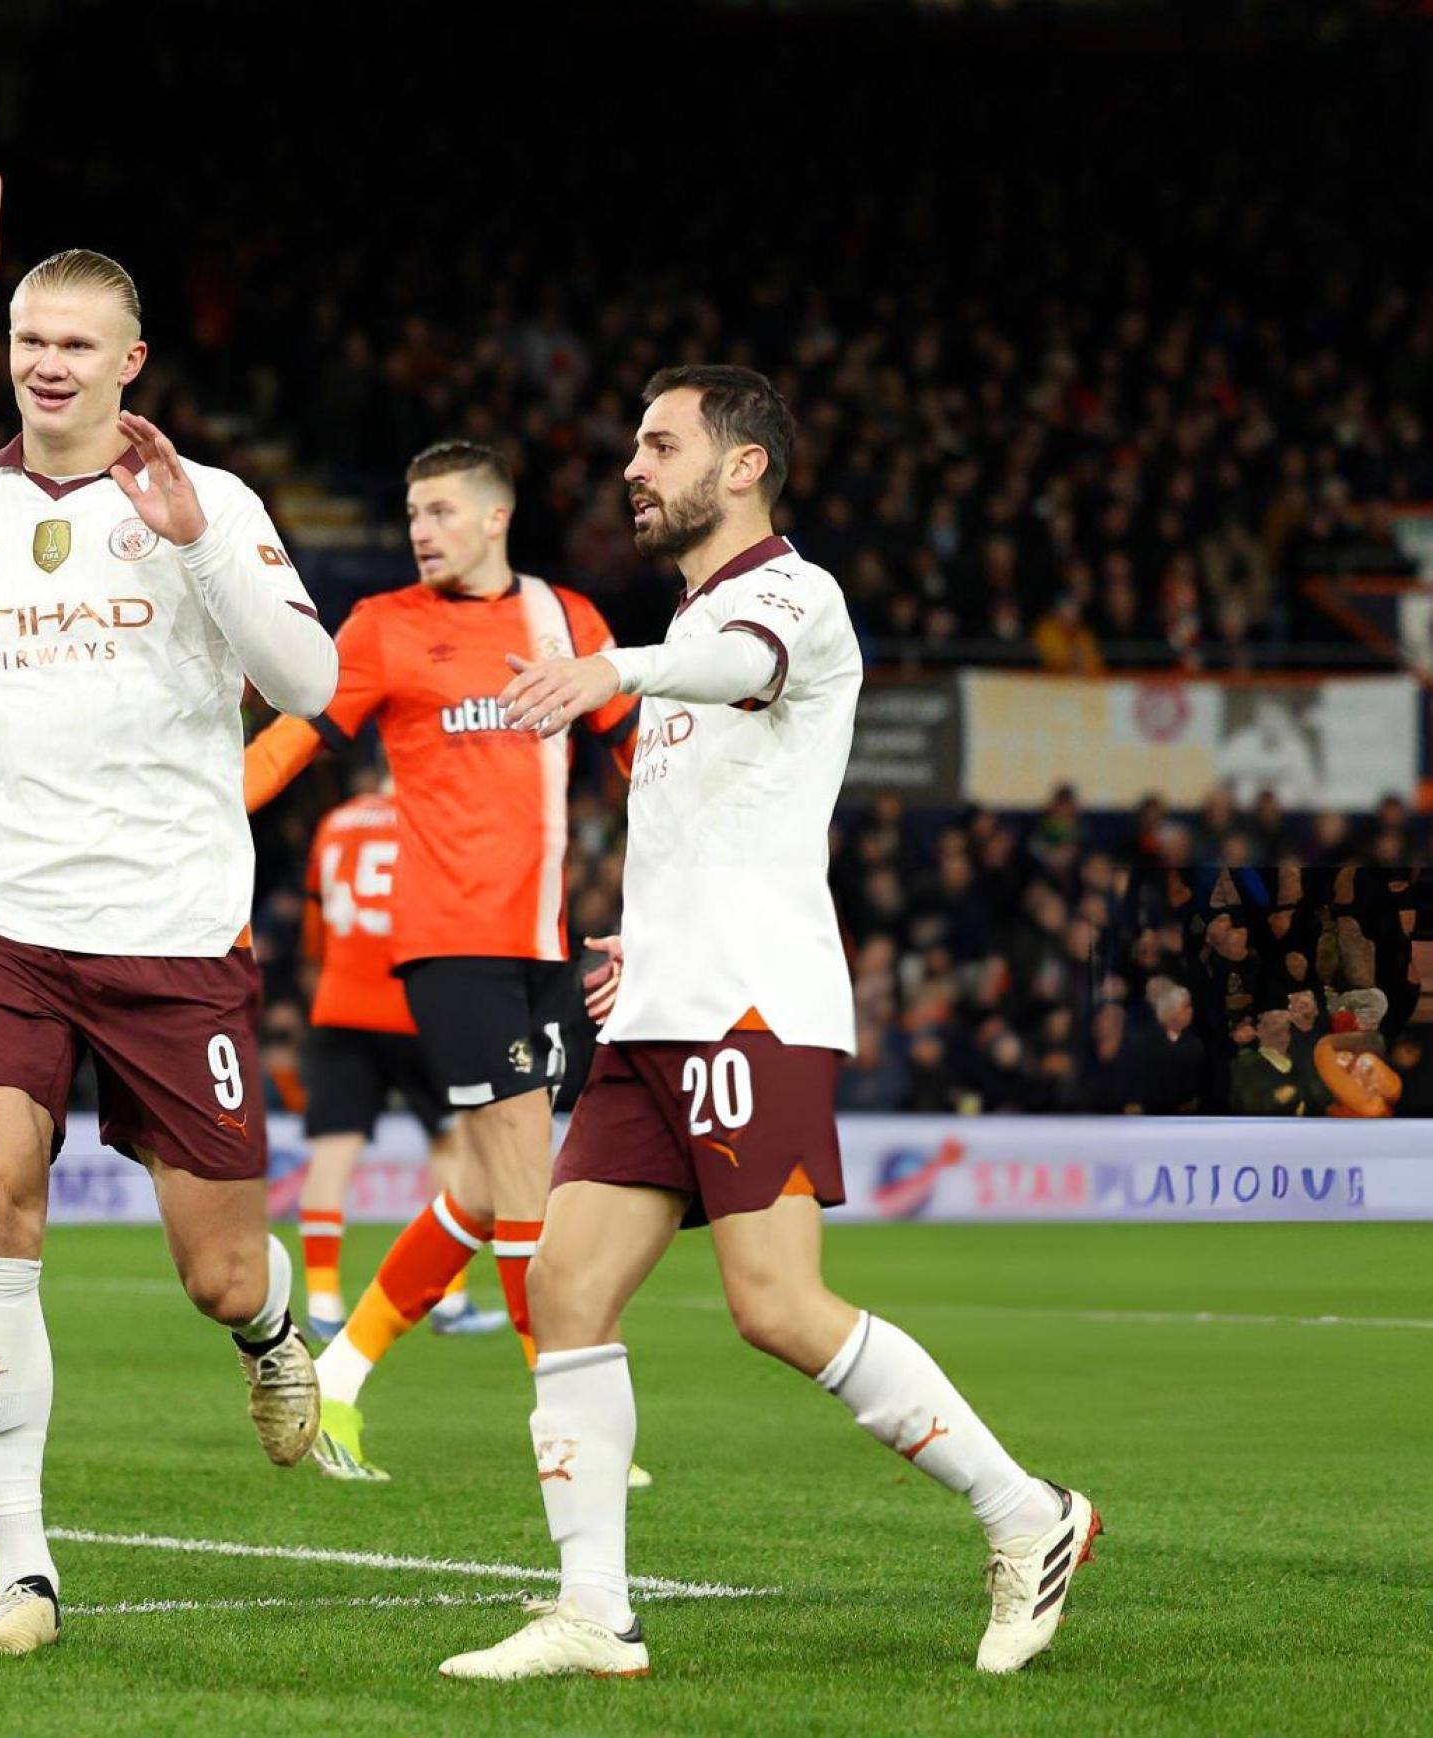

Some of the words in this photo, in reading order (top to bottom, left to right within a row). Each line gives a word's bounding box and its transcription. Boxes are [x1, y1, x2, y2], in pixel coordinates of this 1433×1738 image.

[42, 552, 59, 561] FIFA
[319, 839, 400, 937] 45
[207, 1032, 245, 1111] 9
[681, 1047, 754, 1136] 20
